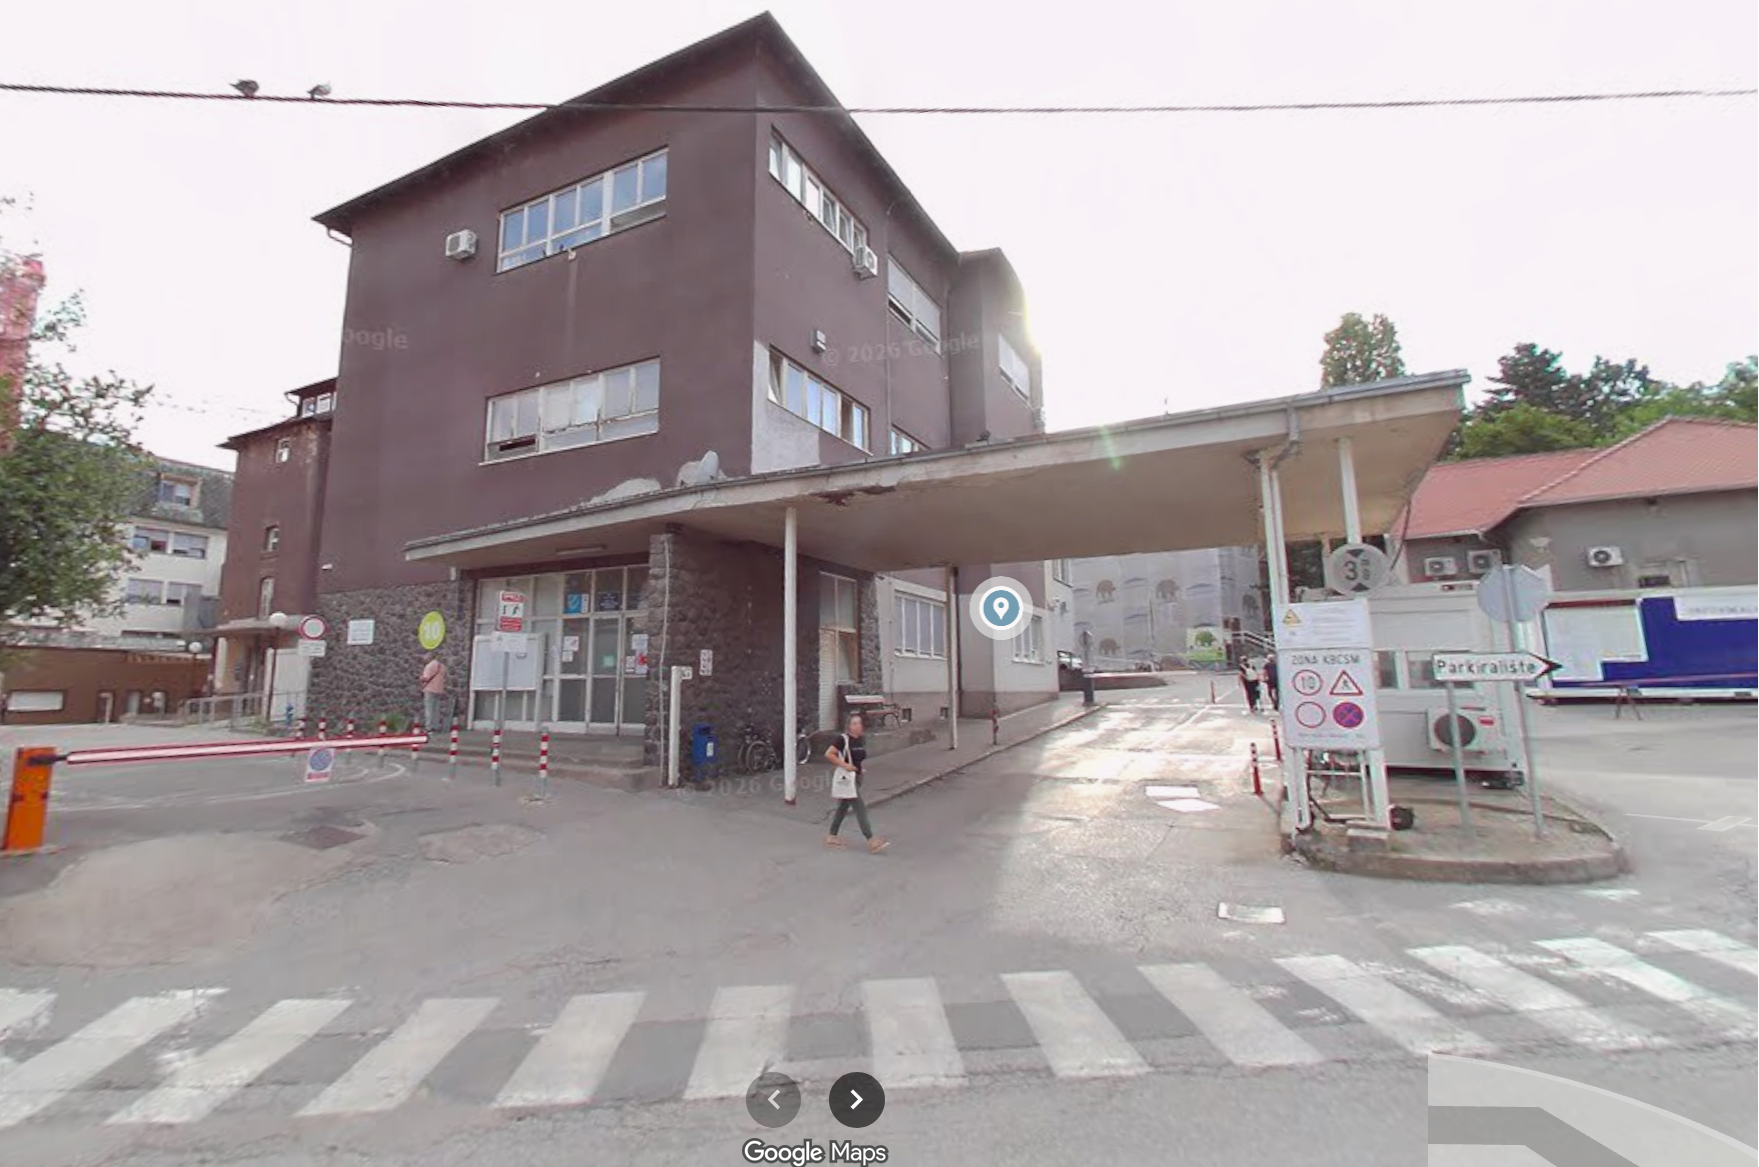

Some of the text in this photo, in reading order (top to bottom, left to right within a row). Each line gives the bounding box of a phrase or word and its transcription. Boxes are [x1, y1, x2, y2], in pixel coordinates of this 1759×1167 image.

[1343, 560, 1358, 580] 3
[424, 621, 440, 639] 10
[1291, 654, 1360, 665] ZONA KBCSM
[1437, 658, 1535, 674] Parkiralište
[1300, 675, 1315, 690] 10
